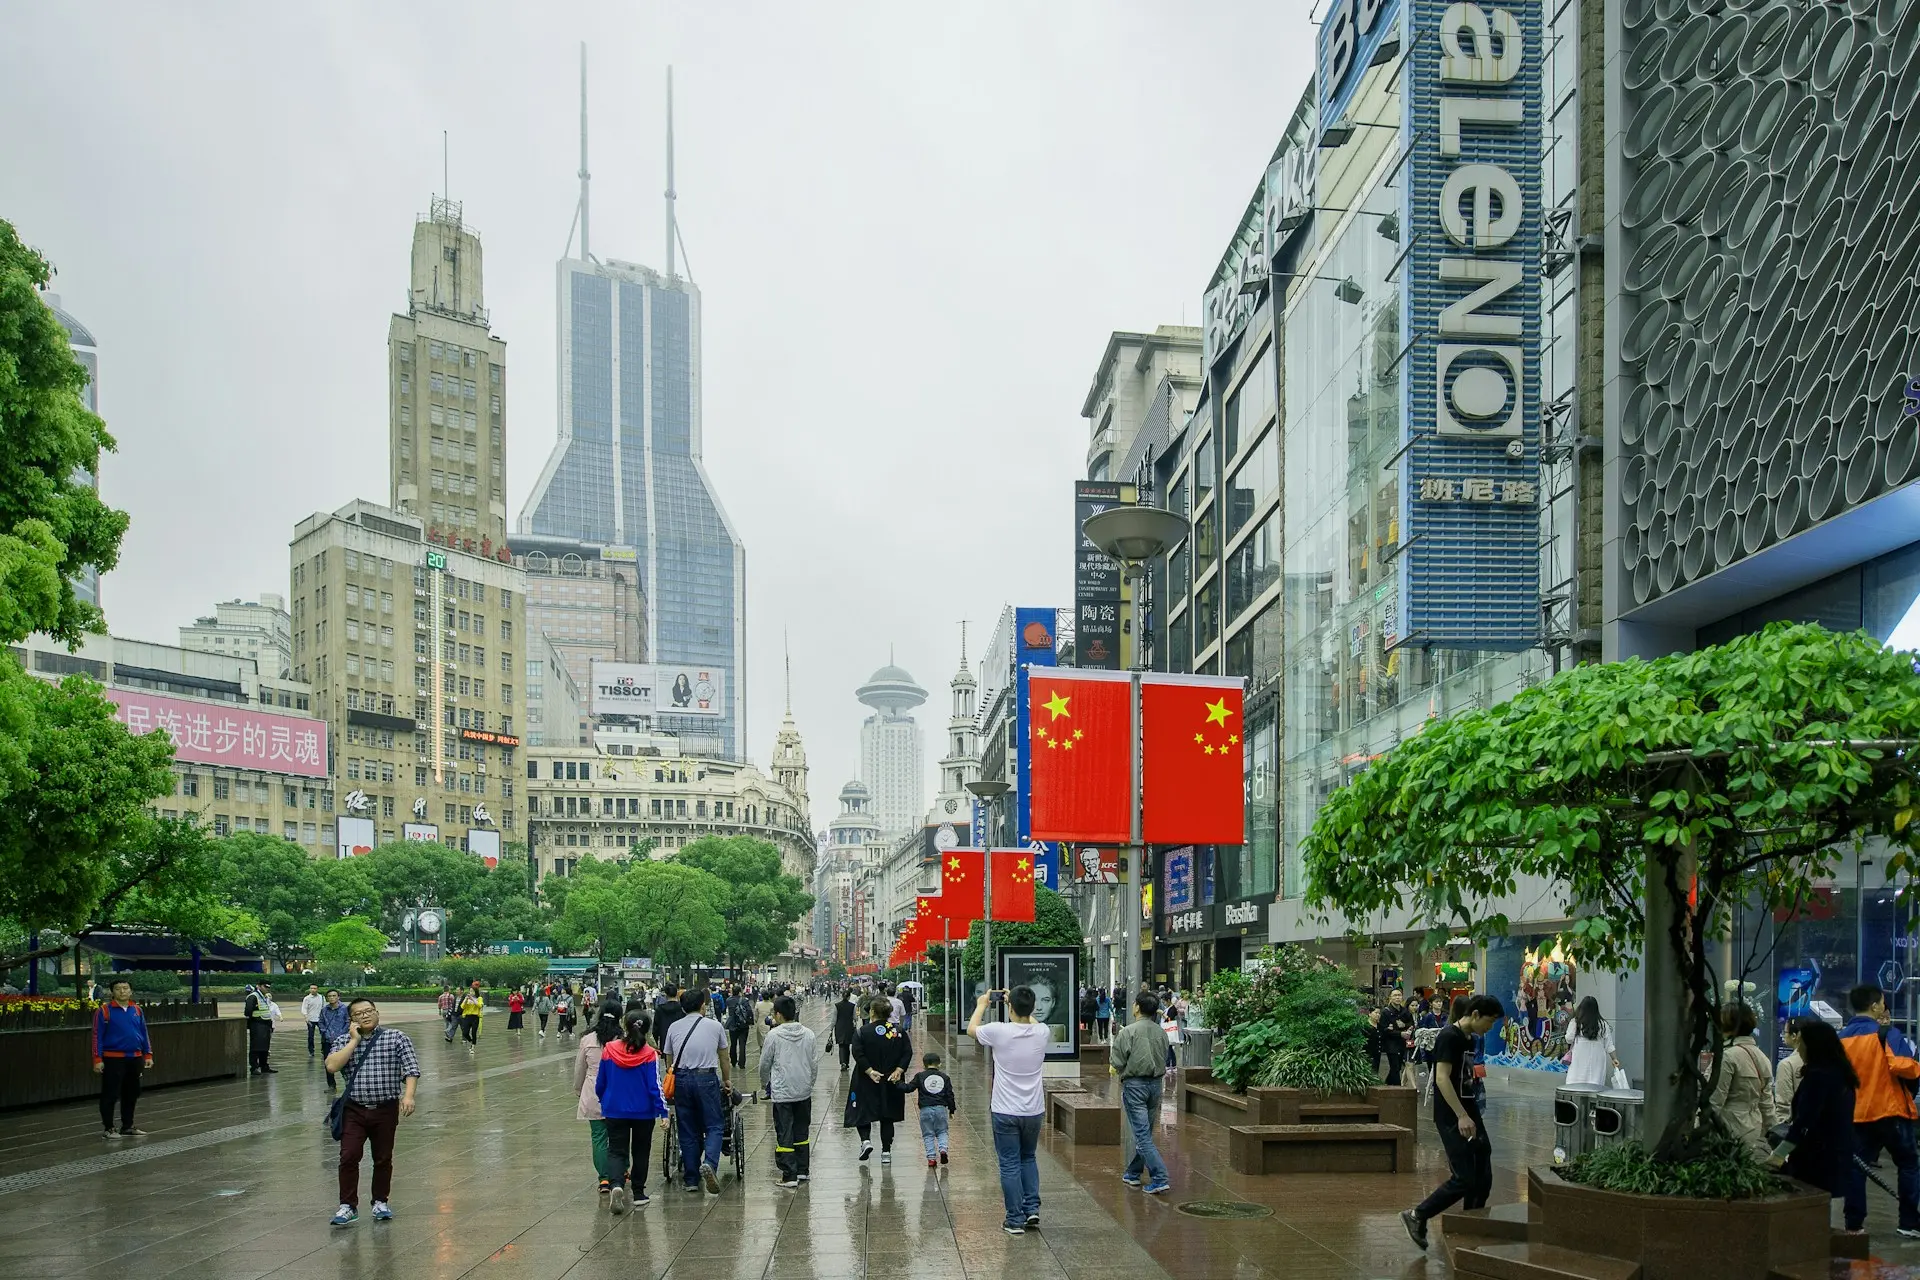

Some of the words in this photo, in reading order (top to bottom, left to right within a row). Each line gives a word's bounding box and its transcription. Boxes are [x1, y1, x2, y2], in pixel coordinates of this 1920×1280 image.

[1420, 478, 1537, 504] 班尼路
[1091, 571, 1107, 579] 中心
[1082, 605, 1115, 621] 陶瓷
[598, 685, 651, 697] TISSOT
[113, 703, 320, 766] 民族进步的灵魂
[523, 945, 544, 954] Chez
